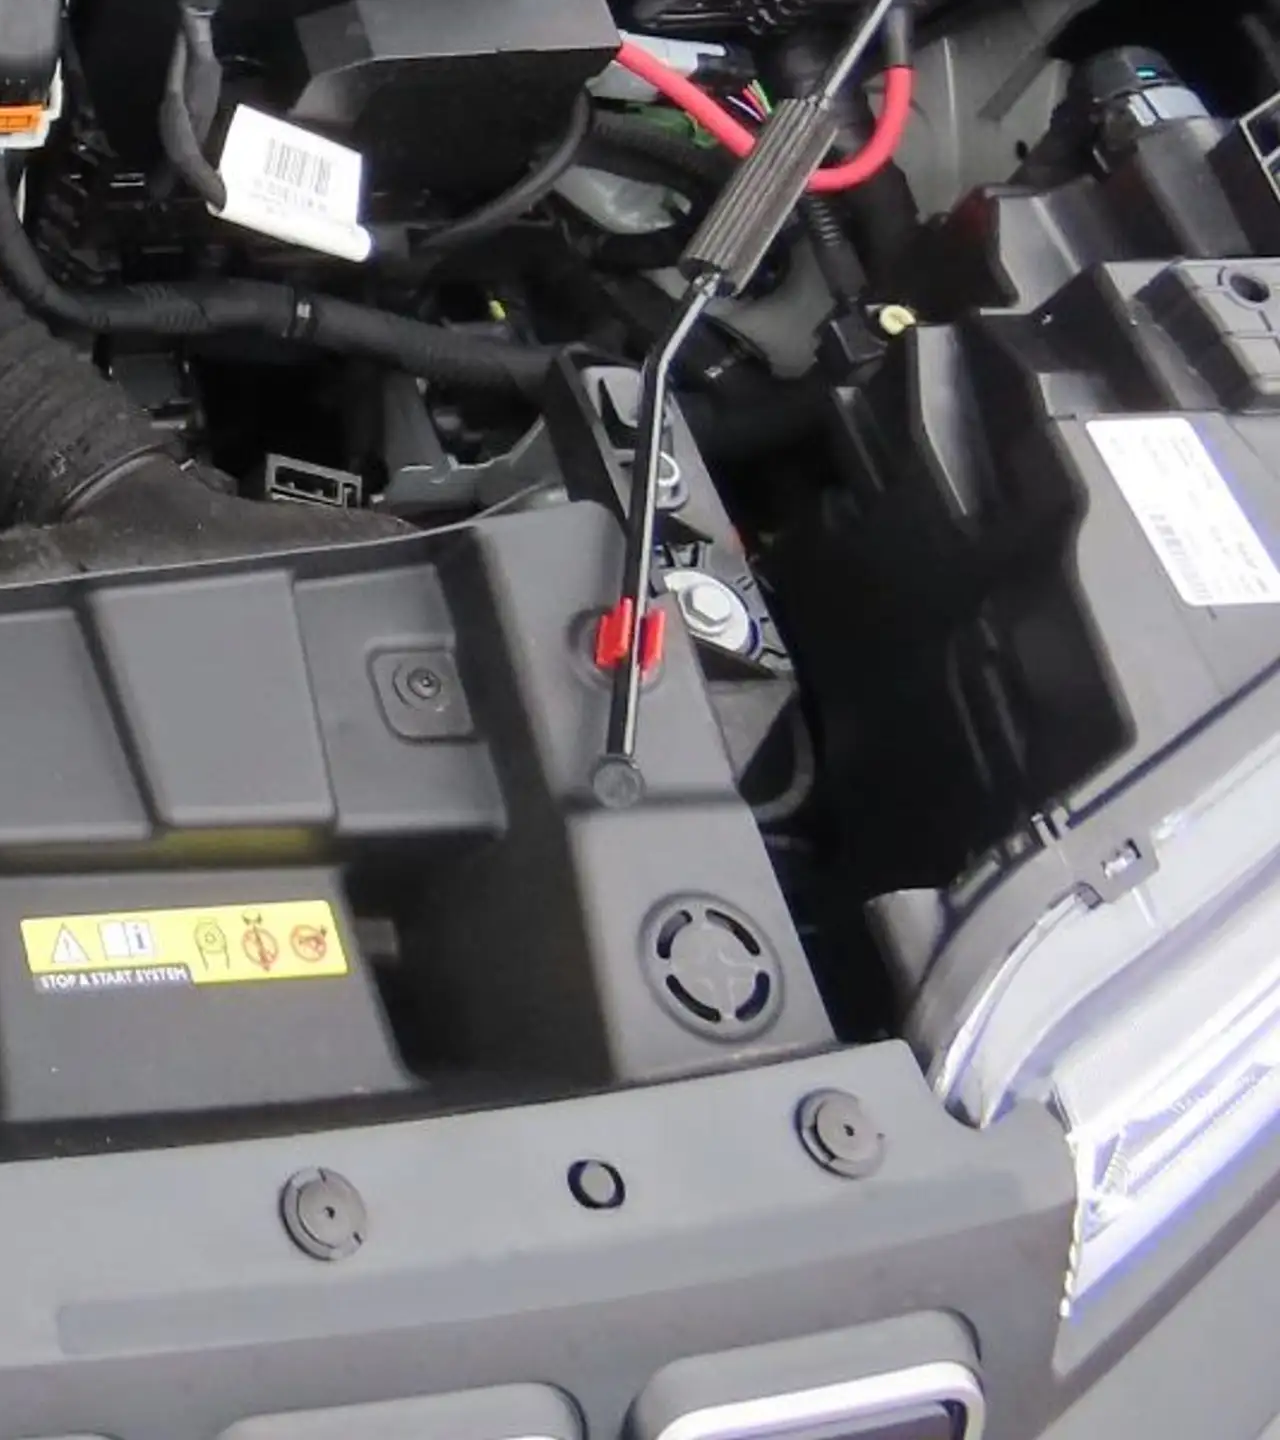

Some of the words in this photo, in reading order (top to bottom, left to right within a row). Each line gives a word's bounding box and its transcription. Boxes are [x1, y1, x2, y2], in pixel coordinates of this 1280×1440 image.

[39, 973, 76, 989] STOP
[90, 970, 134, 986] START
[135, 966, 188, 983] SYSTEM
